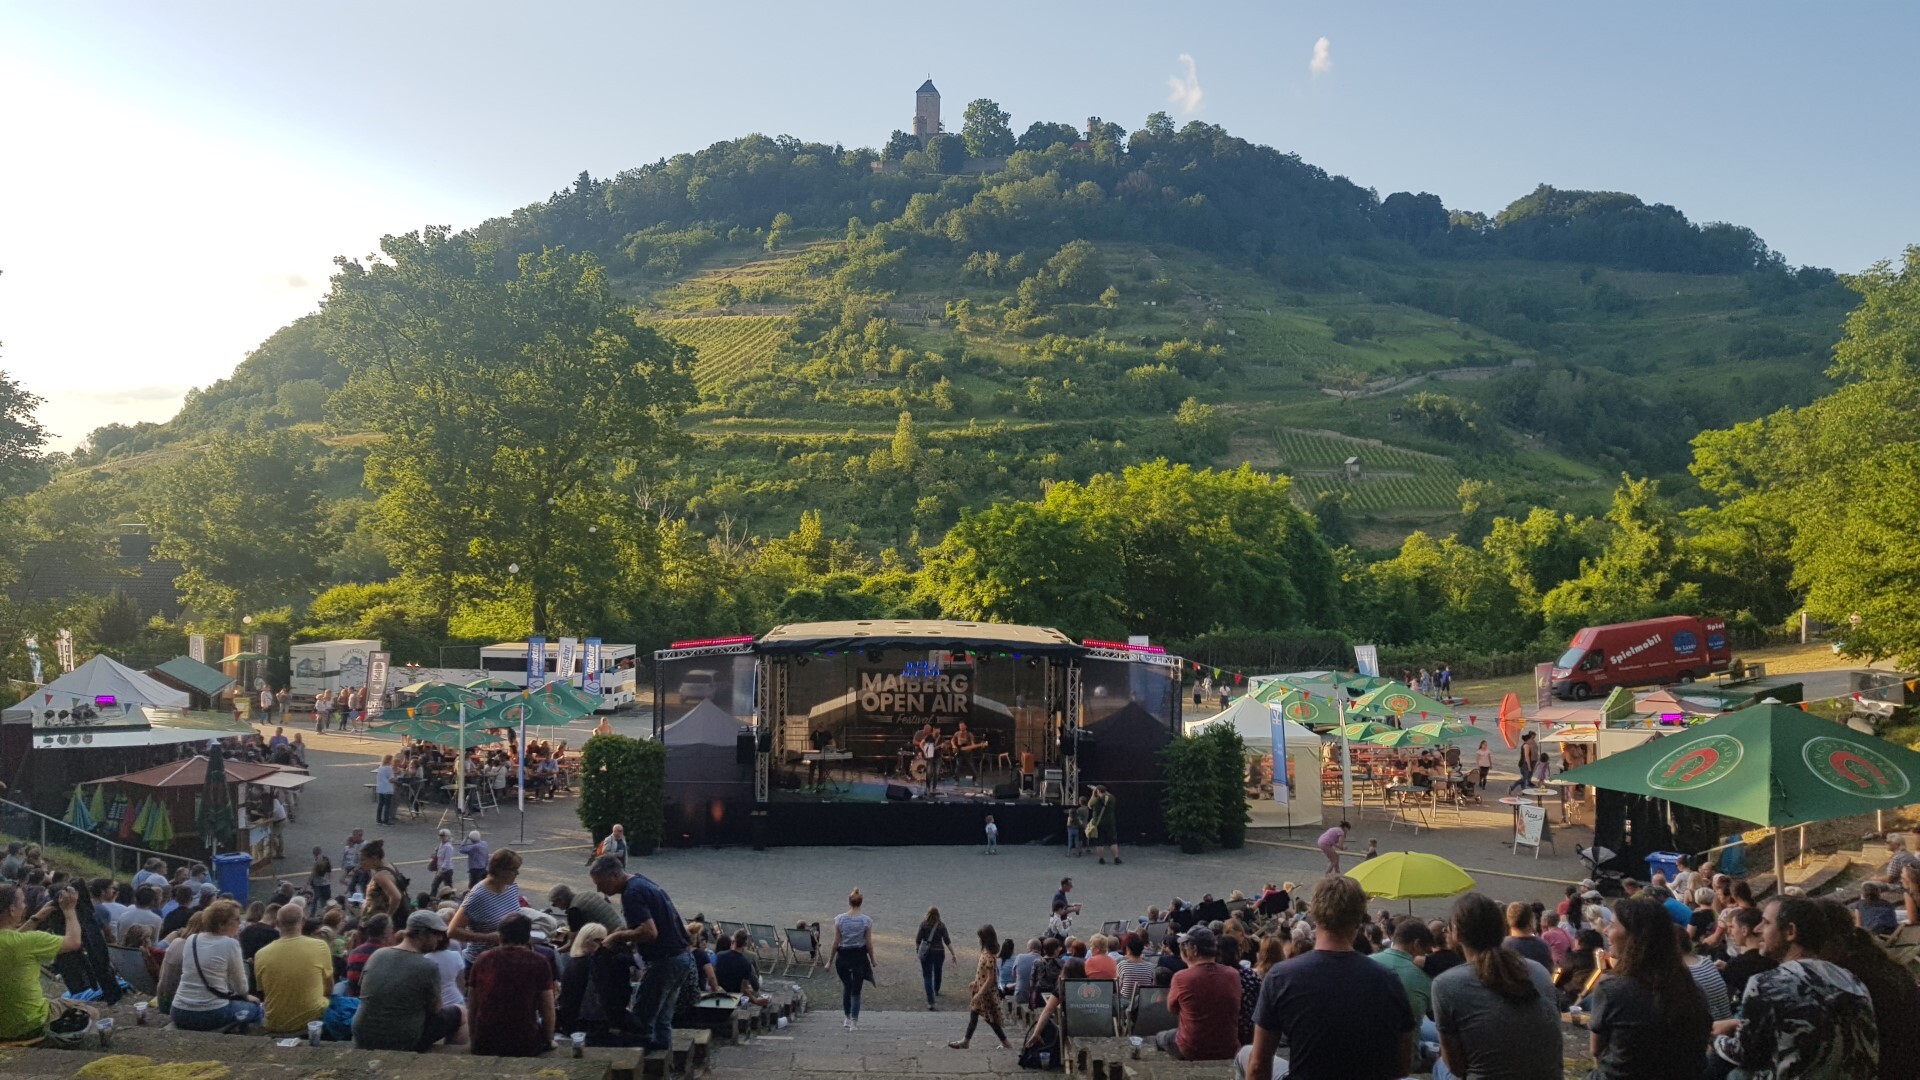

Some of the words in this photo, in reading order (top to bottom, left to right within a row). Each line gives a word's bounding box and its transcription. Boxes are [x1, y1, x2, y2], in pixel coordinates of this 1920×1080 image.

[586, 644, 595, 674] llesklar
[1609, 633, 1662, 665] Spielmobil
[861, 672, 969, 693] MAIBERG
[861, 692, 925, 712] OPEN
[931, 693, 969, 713] AIR
[895, 713, 933, 725] Festival
